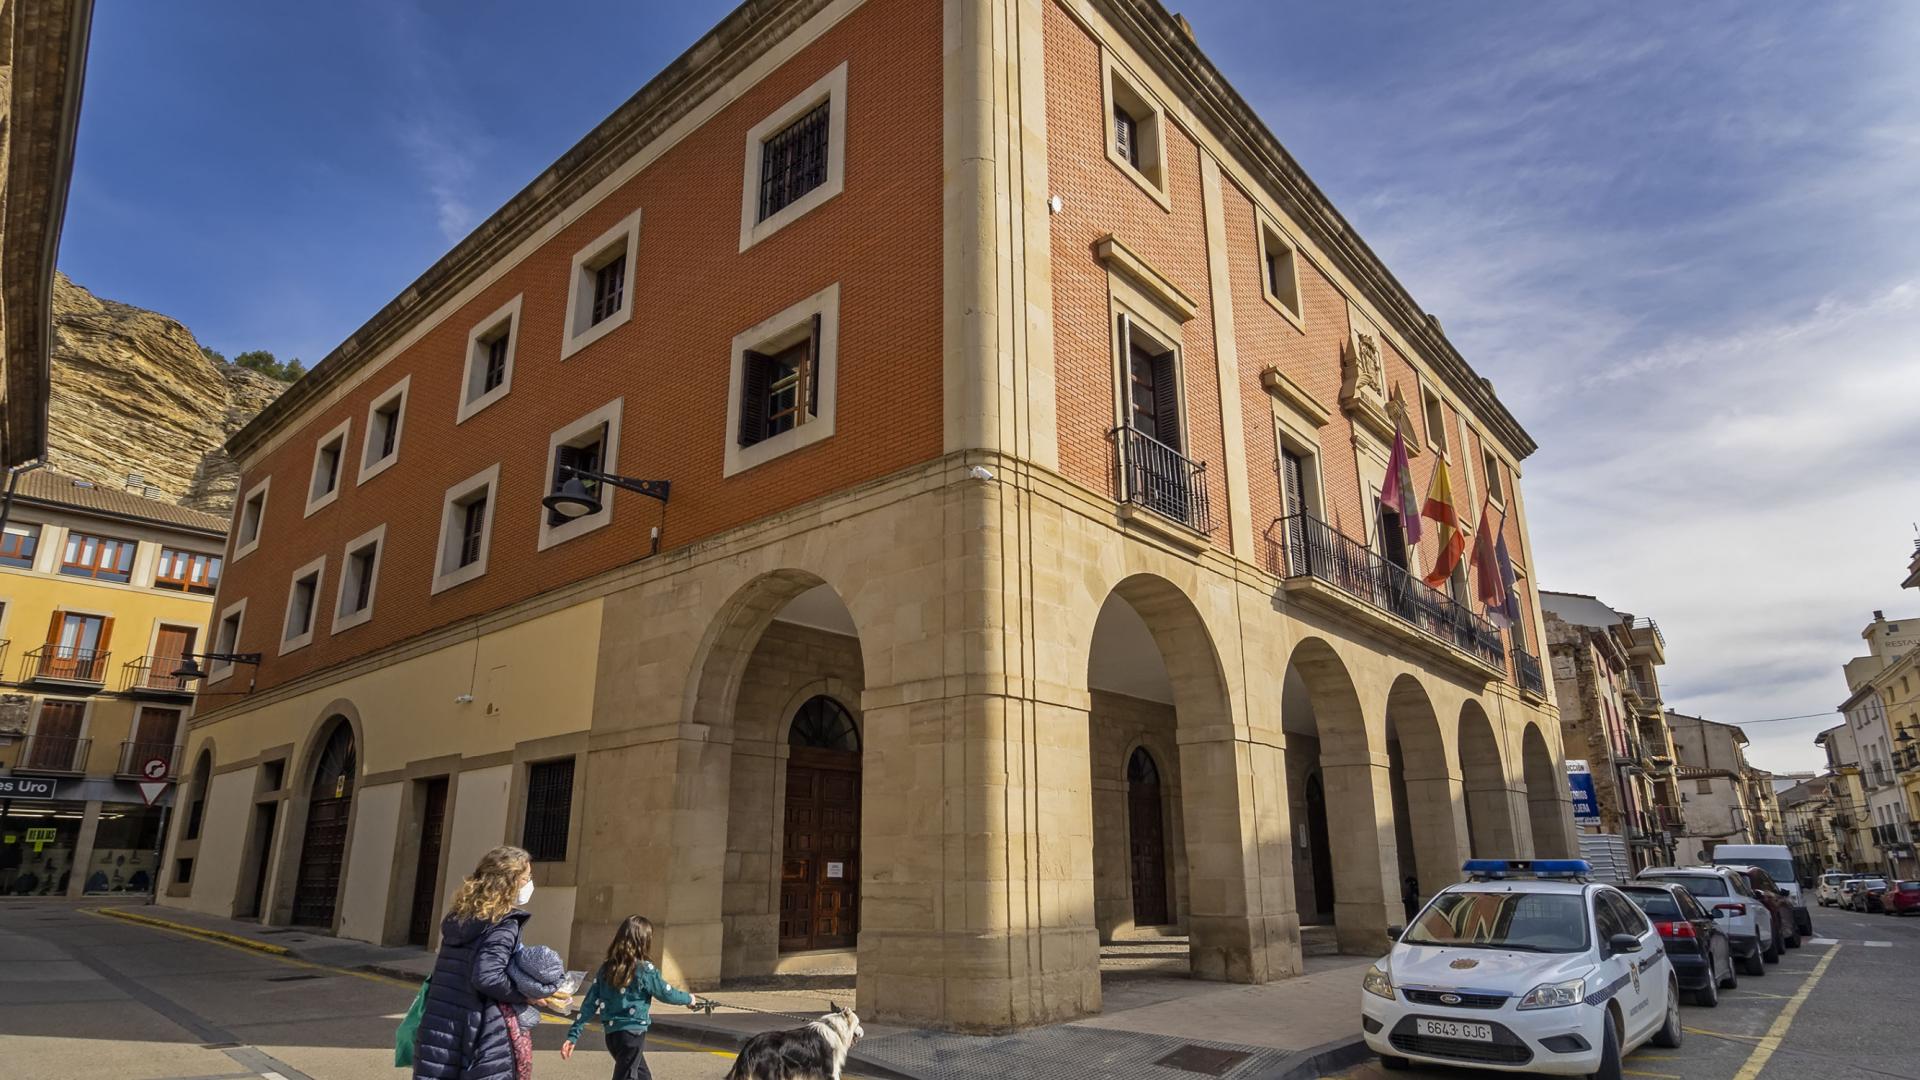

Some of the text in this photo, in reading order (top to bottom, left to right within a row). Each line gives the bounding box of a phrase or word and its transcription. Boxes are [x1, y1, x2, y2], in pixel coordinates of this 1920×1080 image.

[18, 780, 48, 792] Uro
[1427, 1021, 1486, 1039] 6643 GJG
